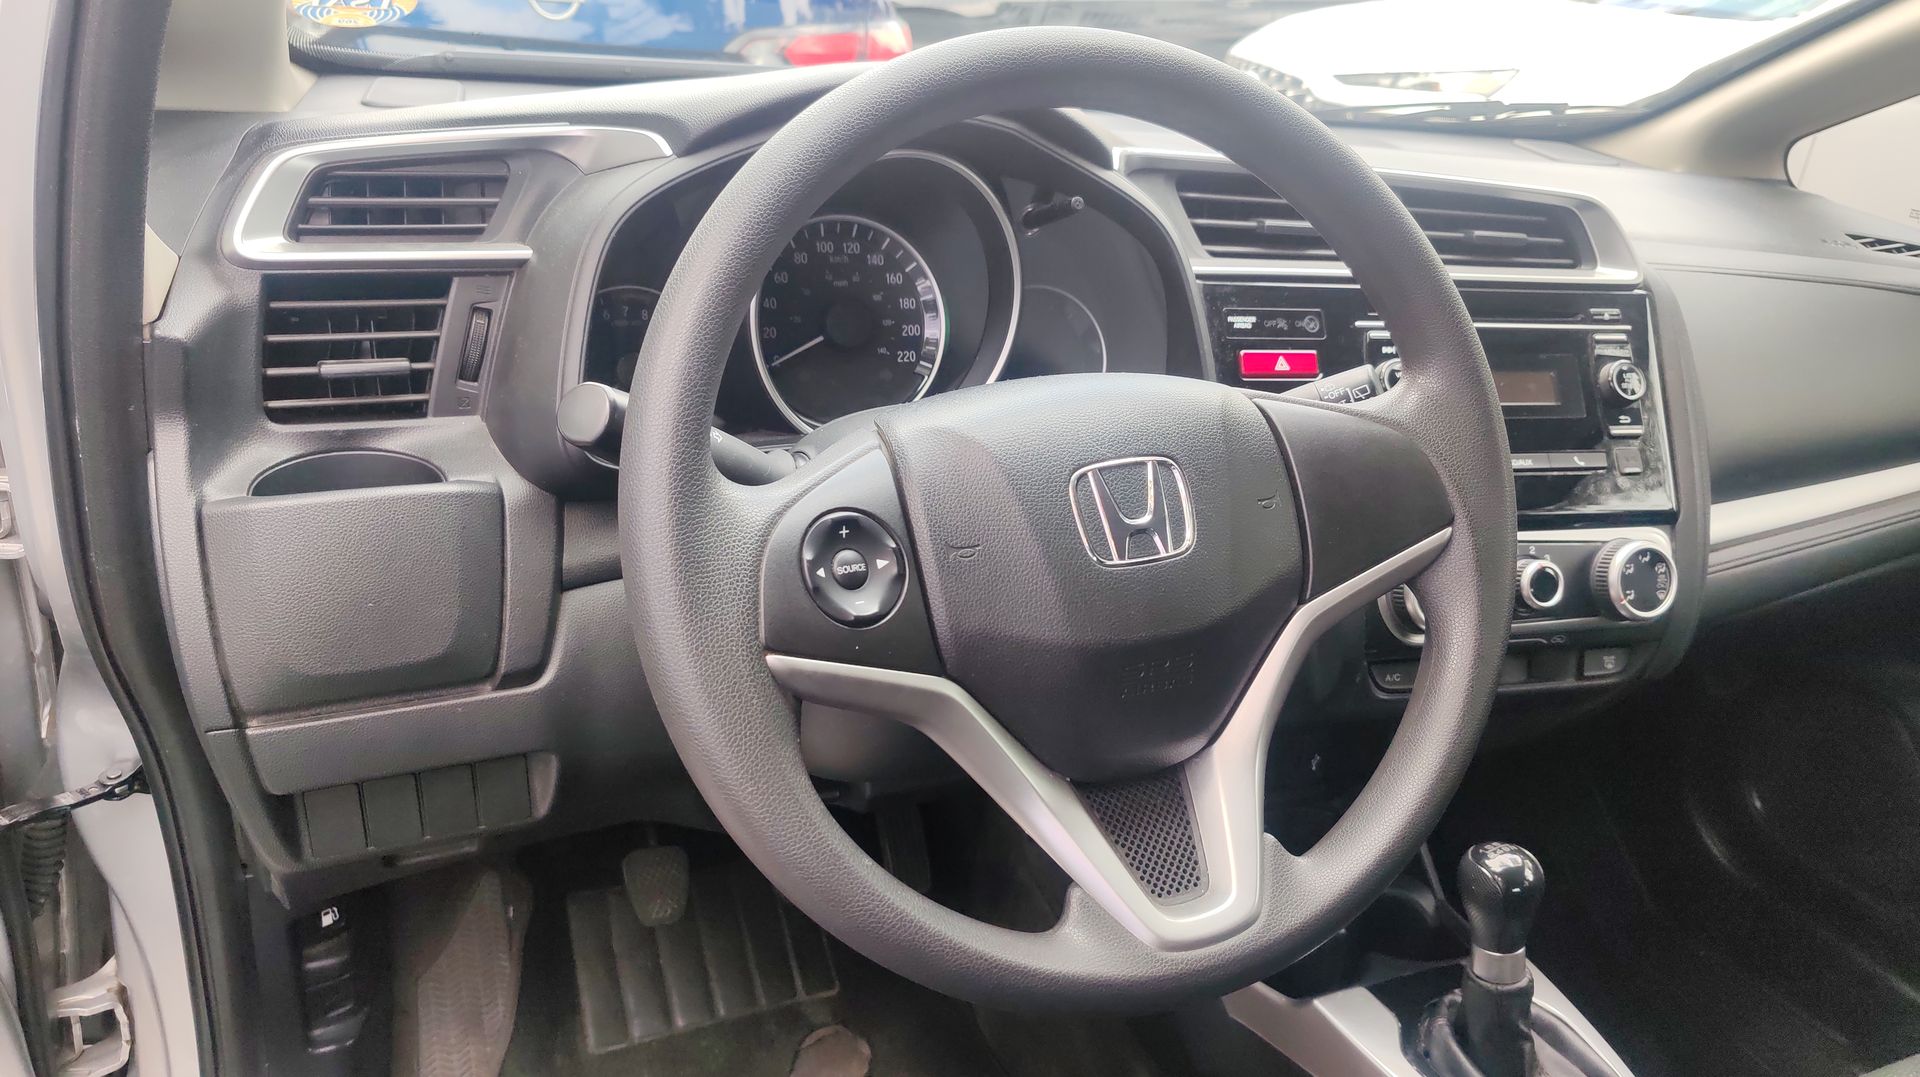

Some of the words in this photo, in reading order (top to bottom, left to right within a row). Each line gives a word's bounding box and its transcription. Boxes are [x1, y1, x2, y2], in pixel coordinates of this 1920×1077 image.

[816, 241, 834, 253] 100
[842, 242, 860, 254] 120
[794, 252, 808, 264] 80
[829, 256, 849, 264] km/h
[866, 254, 884, 266] 140
[774, 272, 789, 283] 60
[886, 273, 903, 284] 160
[763, 298, 777, 309] 40
[899, 298, 916, 309] 180
[641, 309, 648, 320] 8
[763, 327, 777, 338] 20
[902, 324, 921, 336] 200
[897, 350, 916, 362] 220
[1529, 546, 1536, 554] 2
[836, 563, 867, 575] SOURCE
[1384, 673, 1401, 682] A/C
